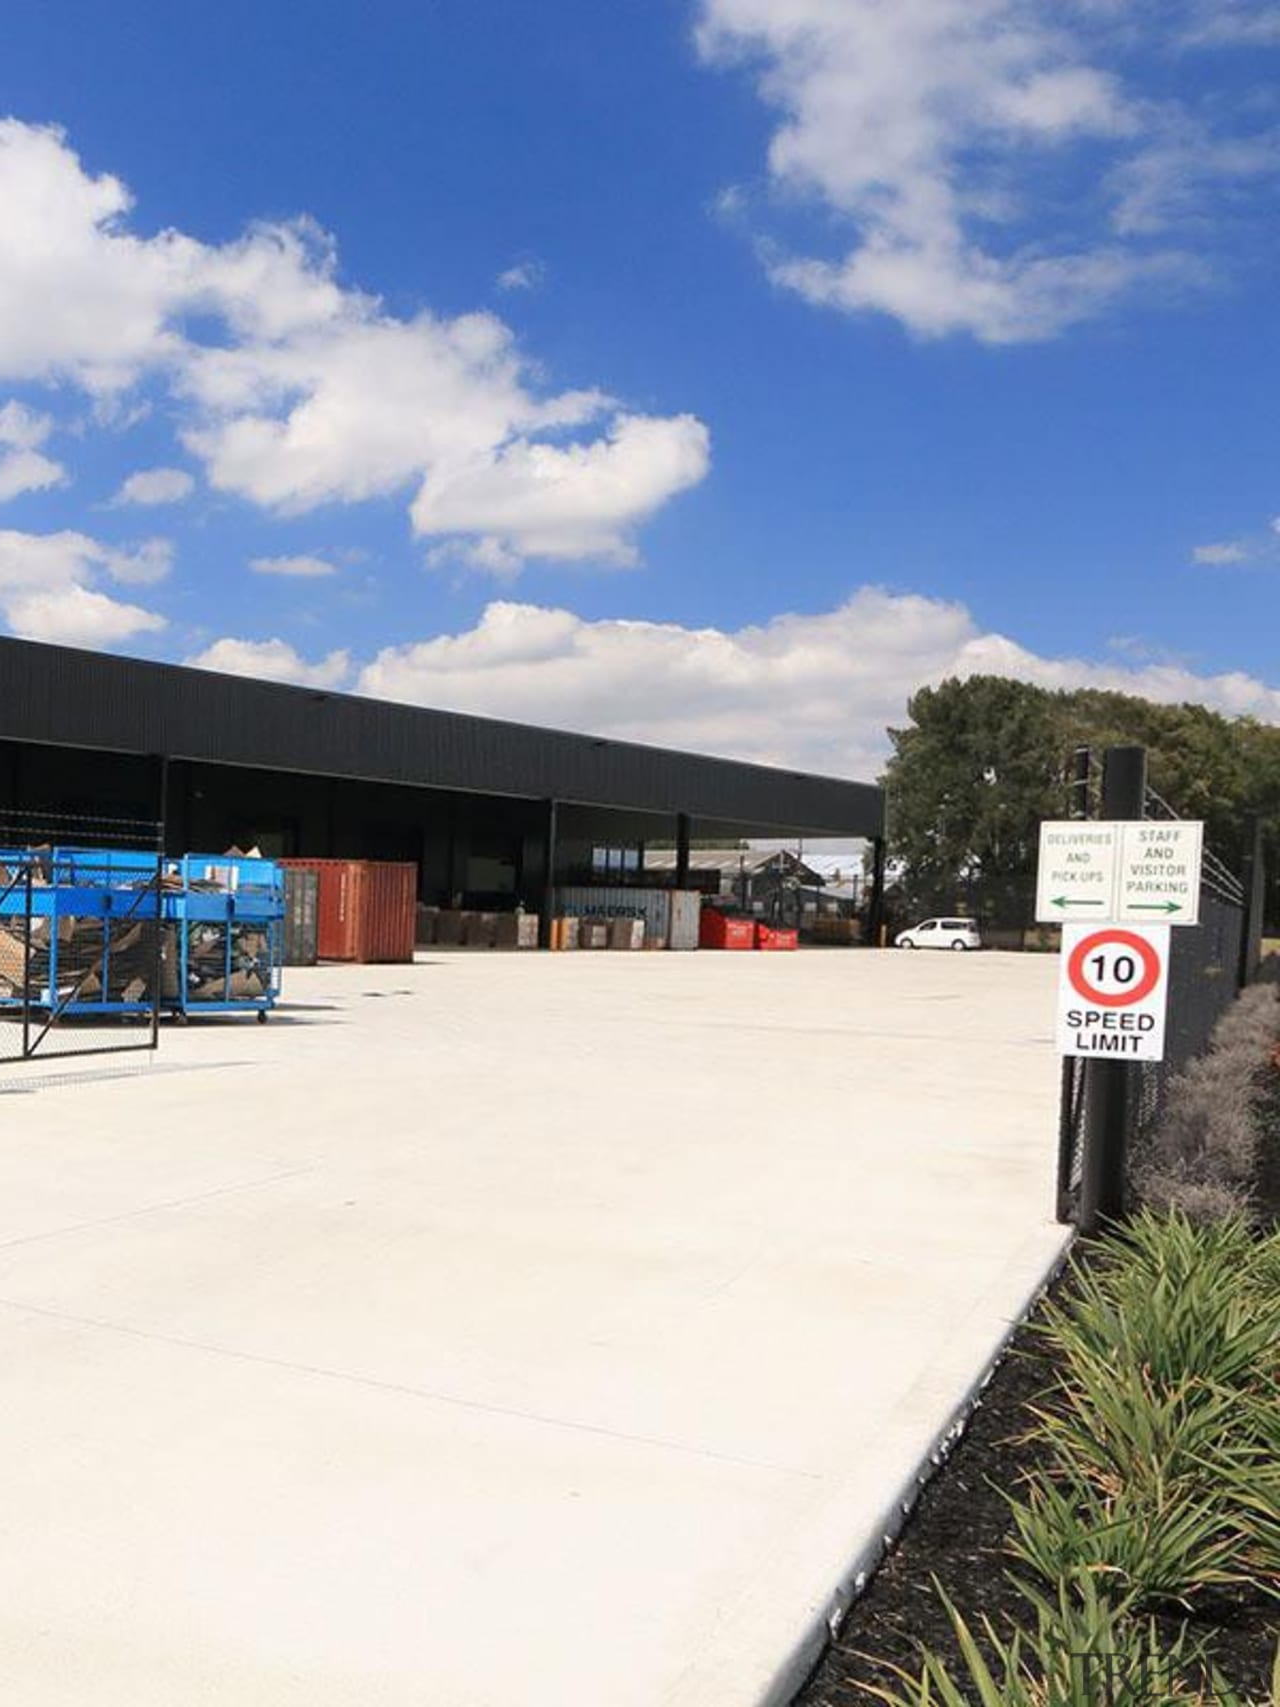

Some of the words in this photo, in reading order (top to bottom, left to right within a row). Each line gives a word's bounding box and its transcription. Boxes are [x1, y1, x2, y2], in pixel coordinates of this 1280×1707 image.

[1047, 833, 1111, 845] DELIVERIES
[1139, 830, 1180, 842] STAFF
[1066, 852, 1090, 863] AND
[1144, 847, 1174, 859] AND
[1130, 864, 1186, 876] VISITOR
[1051, 871, 1076, 882] PICK
[1081, 871, 1104, 882] UPS
[1126, 881, 1188, 893] PARKING
[1091, 955, 1135, 983] 10
[1066, 1009, 1155, 1032] SPEED
[1075, 1032, 1144, 1052] LIMIT
